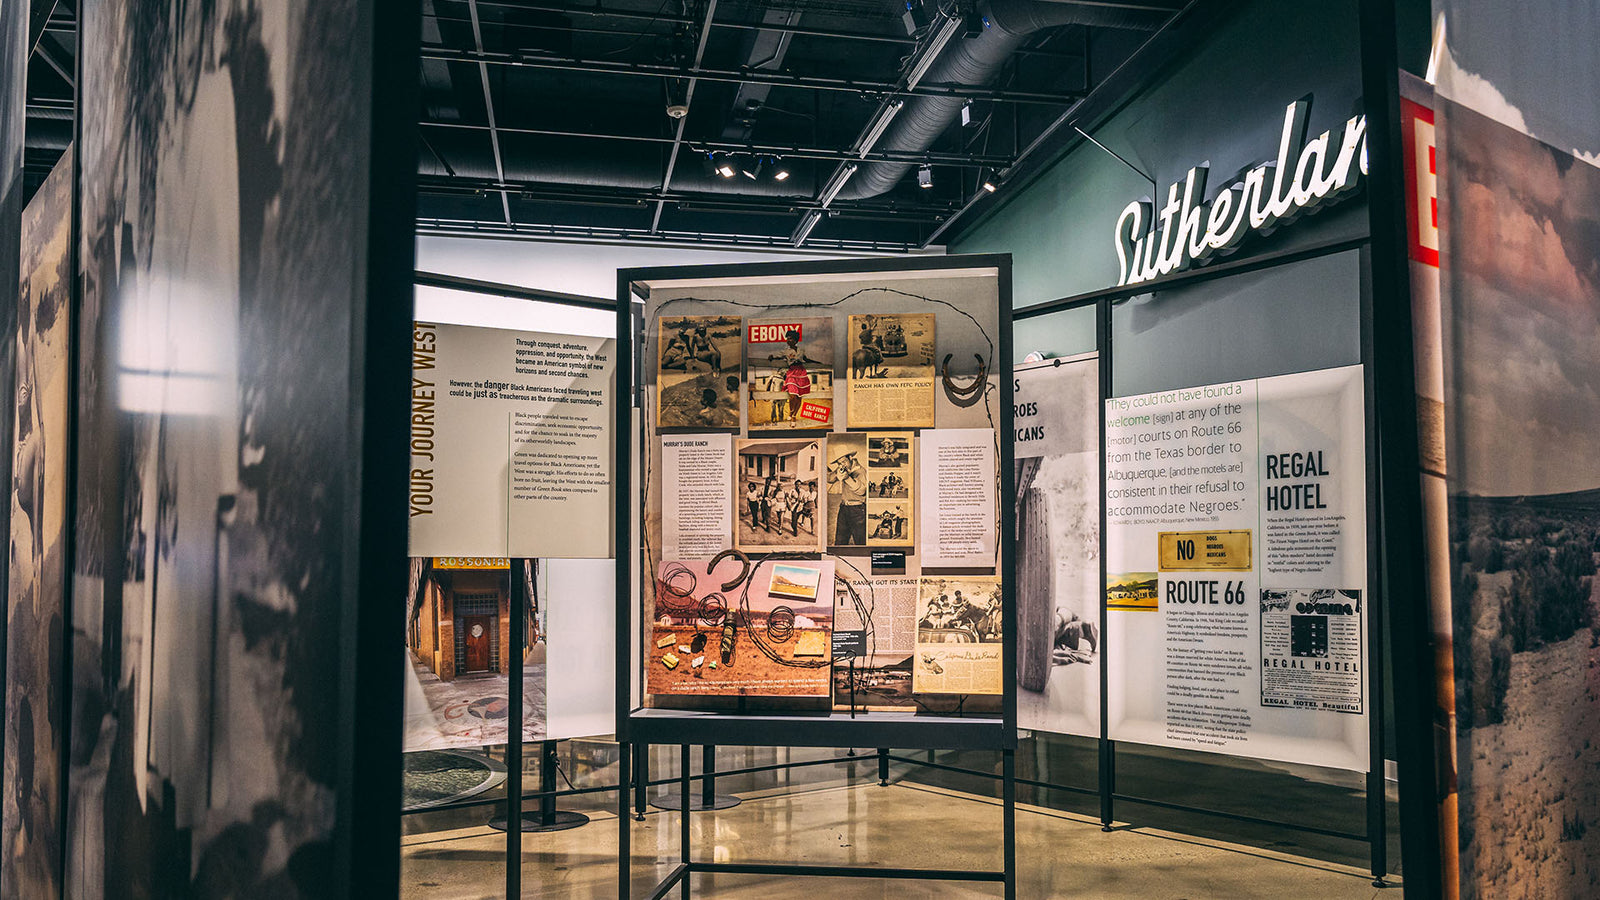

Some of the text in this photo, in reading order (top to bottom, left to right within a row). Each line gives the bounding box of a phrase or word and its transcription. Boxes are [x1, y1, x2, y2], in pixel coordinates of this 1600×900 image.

[516, 339, 536, 347] Through
[557, 352, 585, 360] opportunity,
[473, 389, 487, 399] just
[570, 398, 602, 406] surroundings.
[484, 380, 509, 391] danger
[568, 388, 589, 396] traveling
[1133, 395, 1158, 407] could
[1161, 394, 1176, 403] not
[1179, 391, 1201, 400] have
[1204, 385, 1233, 398] found
[1236, 385, 1241, 394] a
[410, 322, 436, 517] YOUR JOURNEY WEST
[1107, 403, 1241, 427] welcome [sign] at any of the
[1108, 422, 1241, 447] [motor] courts on Route 66
[1108, 443, 1241, 462] from the Texas border to
[1108, 462, 1243, 481] Albuquerque, [and the motels are]
[1267, 451, 1329, 479] REGAL
[1108, 480, 1244, 498] consistent in their refusal to
[1267, 484, 1326, 511] HOTEL
[1108, 502, 1185, 516] accommodate
[1177, 540, 1194, 560] NO
[1167, 581, 1218, 604] ROUTE
[1225, 581, 1244, 604] 66
[1264, 659, 1358, 672] REGAL HOTEL
